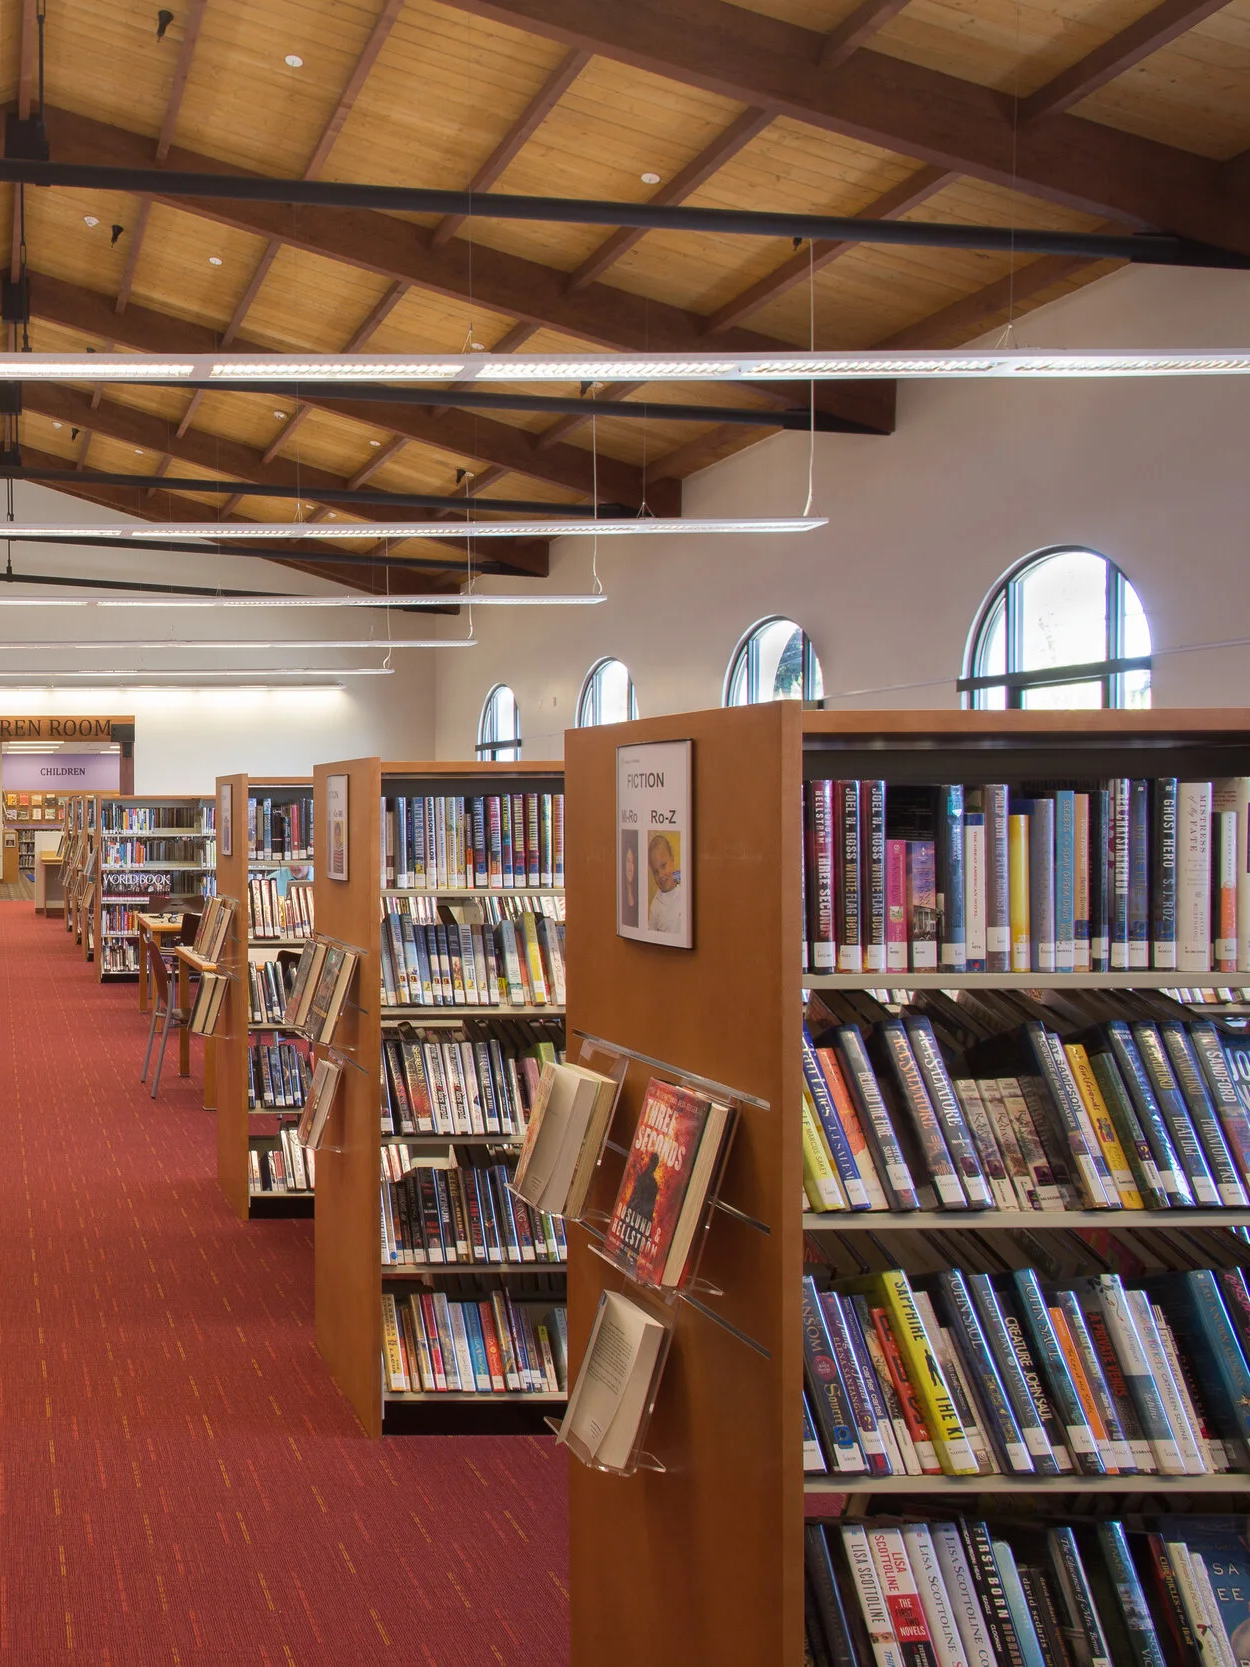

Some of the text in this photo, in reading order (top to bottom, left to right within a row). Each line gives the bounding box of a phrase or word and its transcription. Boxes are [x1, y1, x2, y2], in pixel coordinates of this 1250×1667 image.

[49, 719, 111, 737] ROOM
[40, 767, 86, 777] CHILDREN
[627, 772, 664, 788] FICTION
[474, 816, 483, 849] KELLERMAN
[490, 817, 500, 852] KELLERMAN
[650, 809, 676, 824] Ro-Z
[815, 790, 825, 844] HELLSTRÖM
[1162, 799, 1174, 834] GHOST
[1189, 820, 1198, 853] FATE
[1199, 794, 1207, 854] MISTRESS
[845, 788, 857, 944] JOEL N. ROSS WHITE FLAG DOWN
[871, 788, 883, 944] JOEL N. ROSS WHITE FLAG DOWN
[994, 789, 1006, 912] PHILIP ROTH THE PLOT AGAINST
[1062, 799, 1071, 919] SECRETS SOAP OPERA Diva
[1115, 793, 1129, 896] RED CHRYSANTHEMUM
[1134, 845, 1146, 865] THE
[1162, 838, 1174, 868] HERO
[103, 874, 172, 886] WORLD BOOK
[817, 851, 830, 938] THREE SECONDS
[1078, 876, 1087, 896] Betty
[1162, 878, 1174, 888] S.
[1162, 901, 1174, 922] ROZ
[893, 1038, 936, 1130] R.A. SALVATORE
[918, 1029, 963, 1128] R.A. SALVATORE
[1036, 1035, 1077, 1129] SCOURGE BETRAYER
[1047, 1036, 1083, 1114] FAY SAMPSON
[1078, 1064, 1101, 1112] Girlfriends
[1205, 1051, 1238, 1103] SANDFORD
[643, 1098, 679, 1135] THREE
[807, 1075, 856, 1181] Lines SALEM
[856, 1070, 889, 1139] BEHOLD THE FIRE
[1172, 1116, 1190, 1140] HEAT
[634, 1125, 686, 1172] SECONDS
[806, 1127, 819, 1155] MARCUS
[814, 1152, 828, 1176] SAKEY
[1199, 1118, 1228, 1166] PHANTOM
[439, 1180, 450, 1223] PLATINUM
[616, 1201, 661, 1244] ROSLUND &
[611, 1219, 658, 1261] HELLSTRÖM
[949, 1275, 984, 1350] JOHN SAUL
[1023, 1279, 1059, 1362] JOHN SAUL
[1199, 1283, 1245, 1388] LAST KNOWN ADDRESS
[833, 1336, 848, 1364] ELENA
[893, 1280, 926, 1342] SAPPHIRE
[934, 1397, 958, 1422] THE
[981, 1290, 1027, 1404] LIGHT DAY JAMIE
[1004, 1316, 1054, 1423] CREATURE JOHN SAUL
[1078, 1330, 1103, 1379] LAST COLONY
[1087, 1313, 1126, 1398] A PRIVATE VENUS
[1124, 1331, 1141, 1365] Westport
[1160, 1330, 1181, 1380] The Reader
[861, 1364, 883, 1418] cartier cartel
[954, 1385, 968, 1410] Names
[1147, 1337, 1188, 1441] Yorkers CATHLEEN SCHINE
[851, 1543, 887, 1624] LISA SCOTTOLINE
[874, 1534, 901, 1593] SCOTTOLINE
[891, 1551, 907, 1574] LISA
[973, 1526, 1010, 1619] FIRST BORN
[1061, 1536, 1085, 1592] The Education
[1158, 1554, 1181, 1607] CHRONICLES
[895, 1606, 915, 1619] FIRST
[898, 1598, 913, 1608] THE
[918, 1543, 959, 1654] LISA SCOTTOLINE
[944, 1535, 984, 1645] LISA SCOTTOLINE
[973, 1563, 1003, 1652] HEAD SEAGLE CLOONAN
[1022, 1577, 1049, 1649] david sedaris
[899, 1625, 926, 1637] NOVELS
[904, 1616, 920, 1628] TWO
